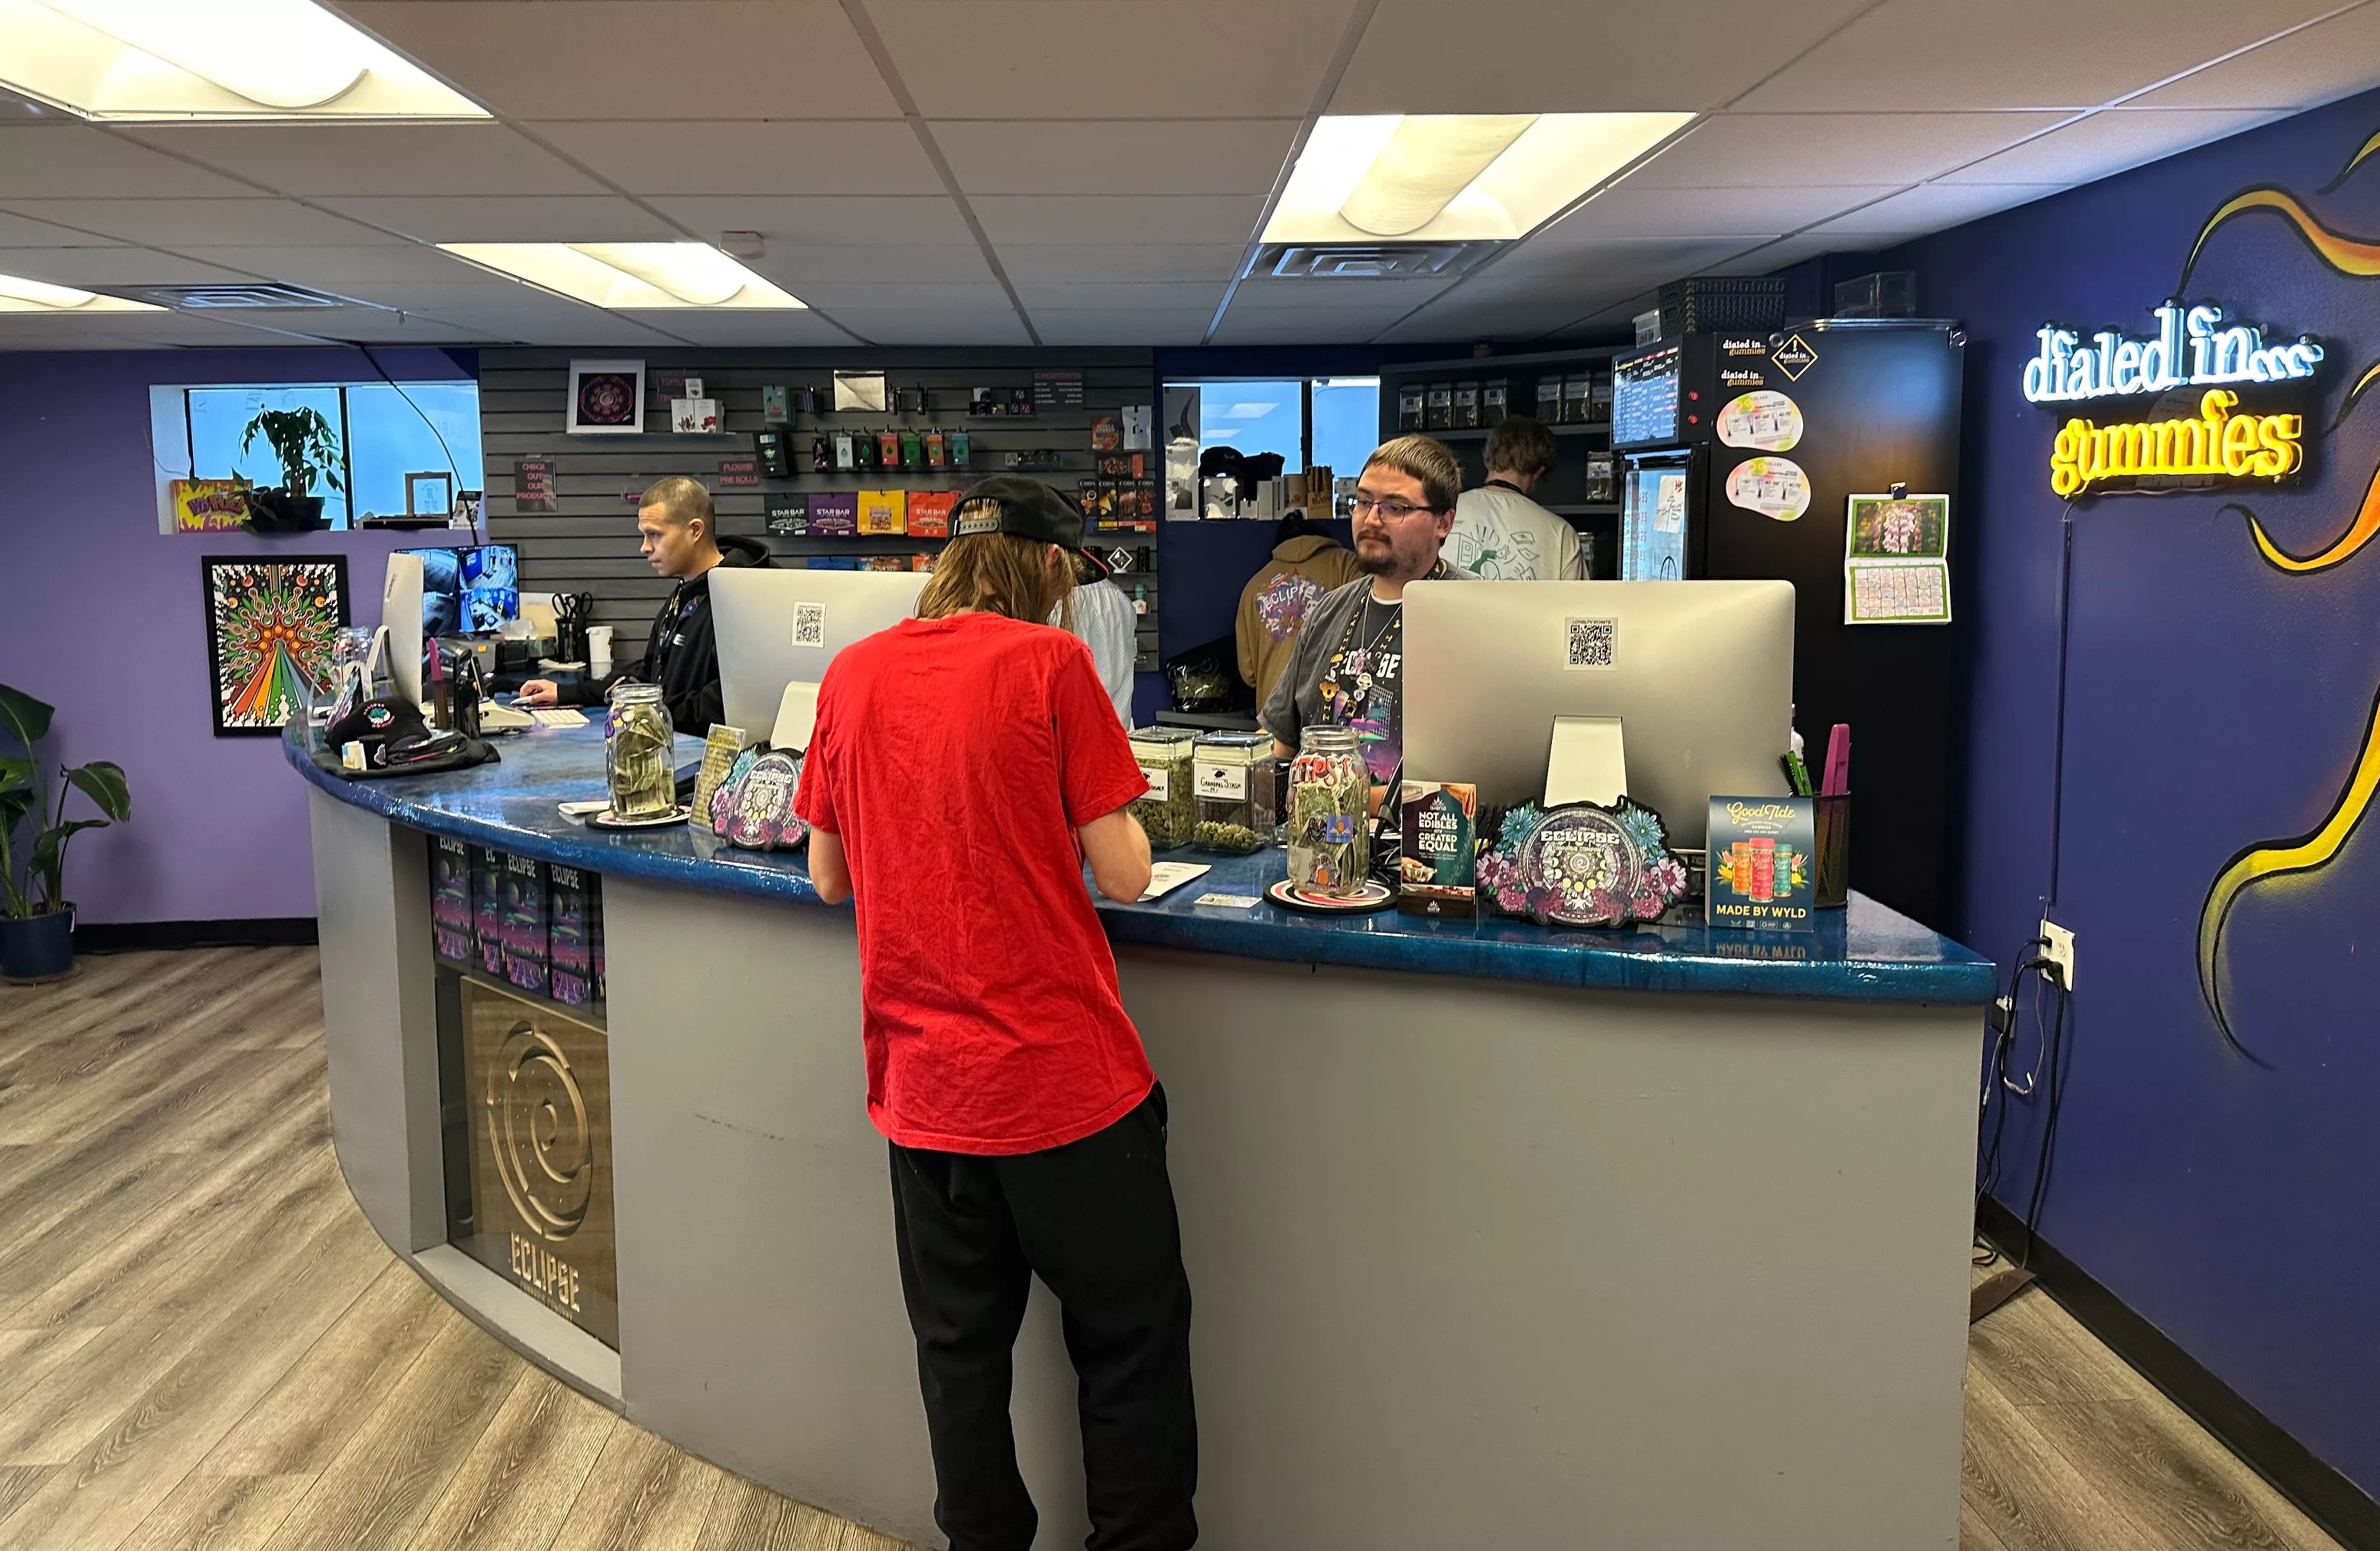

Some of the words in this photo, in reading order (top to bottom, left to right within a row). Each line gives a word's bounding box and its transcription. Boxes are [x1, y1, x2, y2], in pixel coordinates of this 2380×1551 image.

[1723, 339, 1749, 349] dialed
[1729, 348, 1766, 357] gummies
[2022, 305, 2187, 403] dialed
[1721, 370, 1748, 380] dialed
[1726, 378, 1764, 387] gummies
[2050, 389, 2303, 495] gummies
[723, 462, 753, 472] FLOWER
[750, 770, 793, 784] ECLIPSE
[1418, 811, 1438, 821] NOT
[1440, 813, 1458, 822] ALL
[1727, 801, 1765, 824] Good
[1763, 803, 1796, 820] Tide
[1418, 820, 1458, 830] EDIBLES
[1418, 832, 1458, 842] CREATED
[1540, 831, 1620, 844] ECLIPSE
[440, 836, 465, 855] ECLIPSE
[1418, 840, 1458, 852] EQUAL
[507, 852, 536, 878] ECLIPSE
[551, 864, 580, 890] ECLIPSE
[1716, 905, 1750, 916] MADE
[1752, 905, 1770, 917] BY
[1772, 907, 1806, 919] WYLD
[511, 1229, 580, 1313] ECLIPSE
